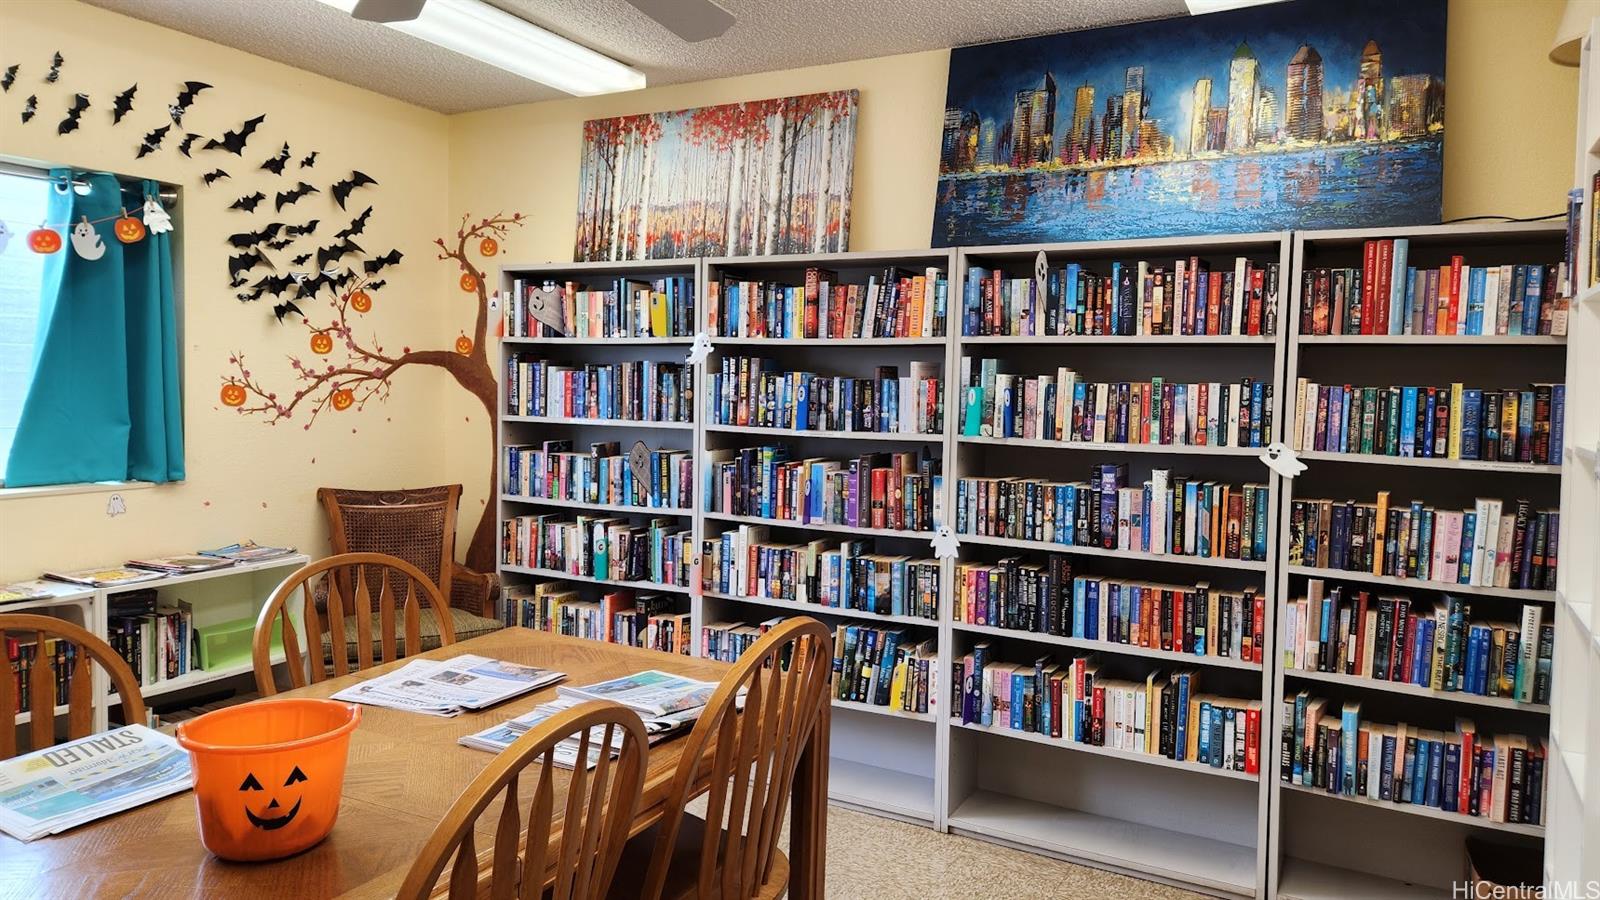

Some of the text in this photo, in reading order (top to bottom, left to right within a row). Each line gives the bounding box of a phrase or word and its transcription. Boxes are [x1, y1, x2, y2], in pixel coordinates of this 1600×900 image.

[491, 301, 497, 309] A
[876, 285, 887, 319] WRONG LIGHT
[1123, 288, 1135, 318] wicked
[1151, 382, 1162, 421] CRAIG JOHNSON
[1517, 504, 1529, 527] LEGACY
[599, 543, 604, 551] C
[1378, 613, 1386, 638] MORTON
[1397, 603, 1406, 639] JOJO MOYES
[1435, 655, 1443, 669] THE
[1505, 664, 1515, 684] DEAD
[42, 730, 143, 768] STALLED
[1345, 731, 1354, 765] WONDER
[1495, 755, 1505, 781] LAST ACT
[1509, 750, 1523, 821] SAY NOTHING BRAD PARKS
